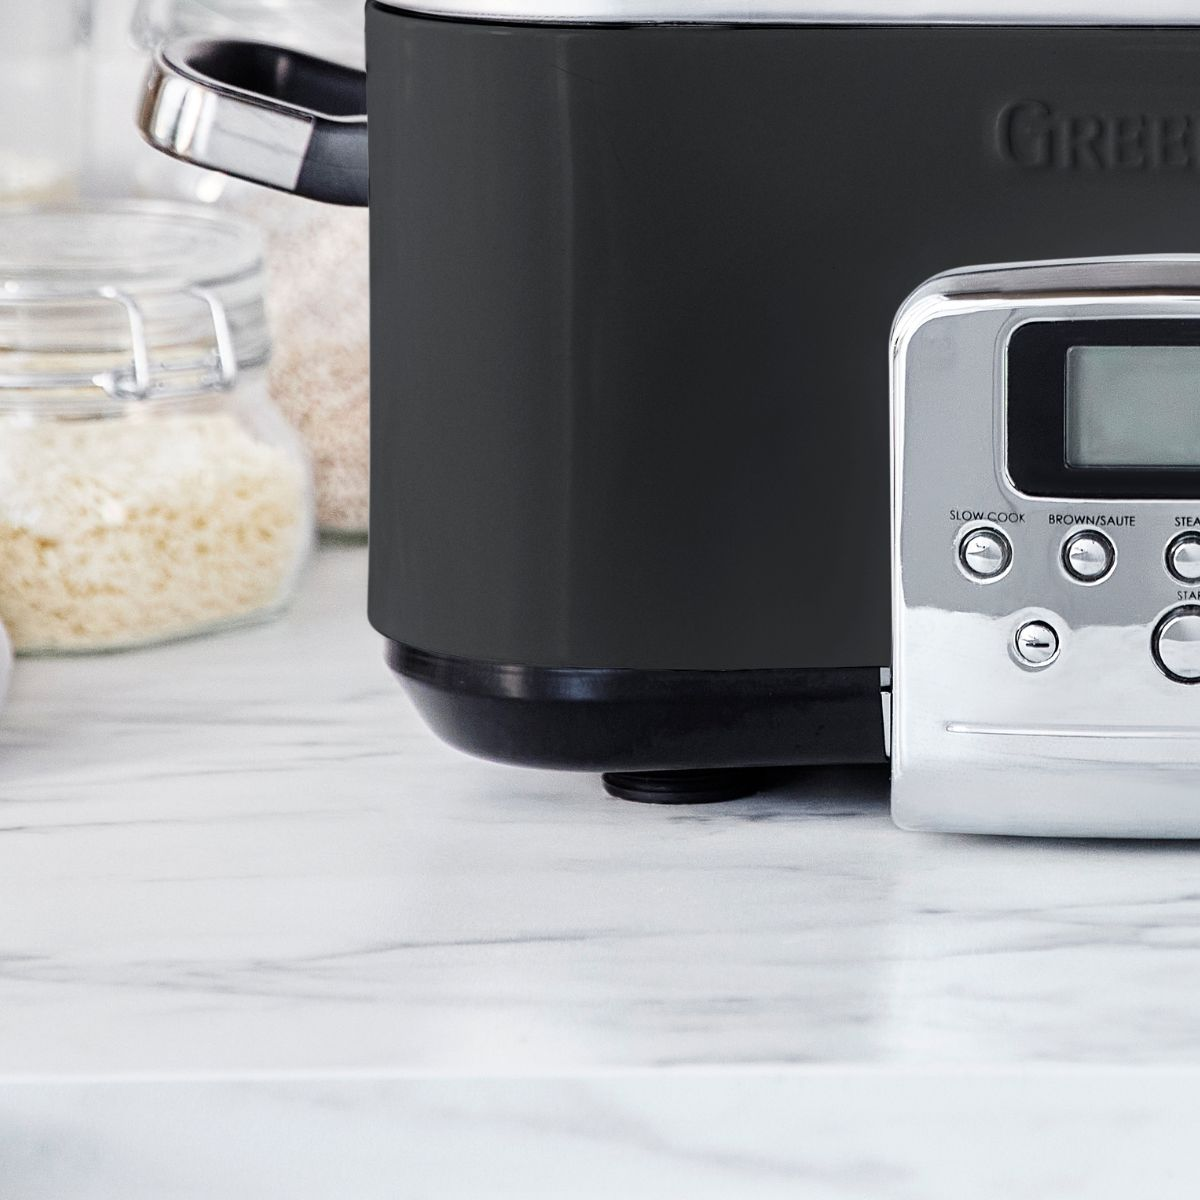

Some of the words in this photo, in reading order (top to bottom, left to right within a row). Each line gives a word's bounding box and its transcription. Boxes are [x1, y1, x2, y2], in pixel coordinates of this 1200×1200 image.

[949, 509, 984, 522] SLOW
[987, 511, 1026, 523] COOK
[1048, 514, 1136, 526] BROWN/SAUTE
